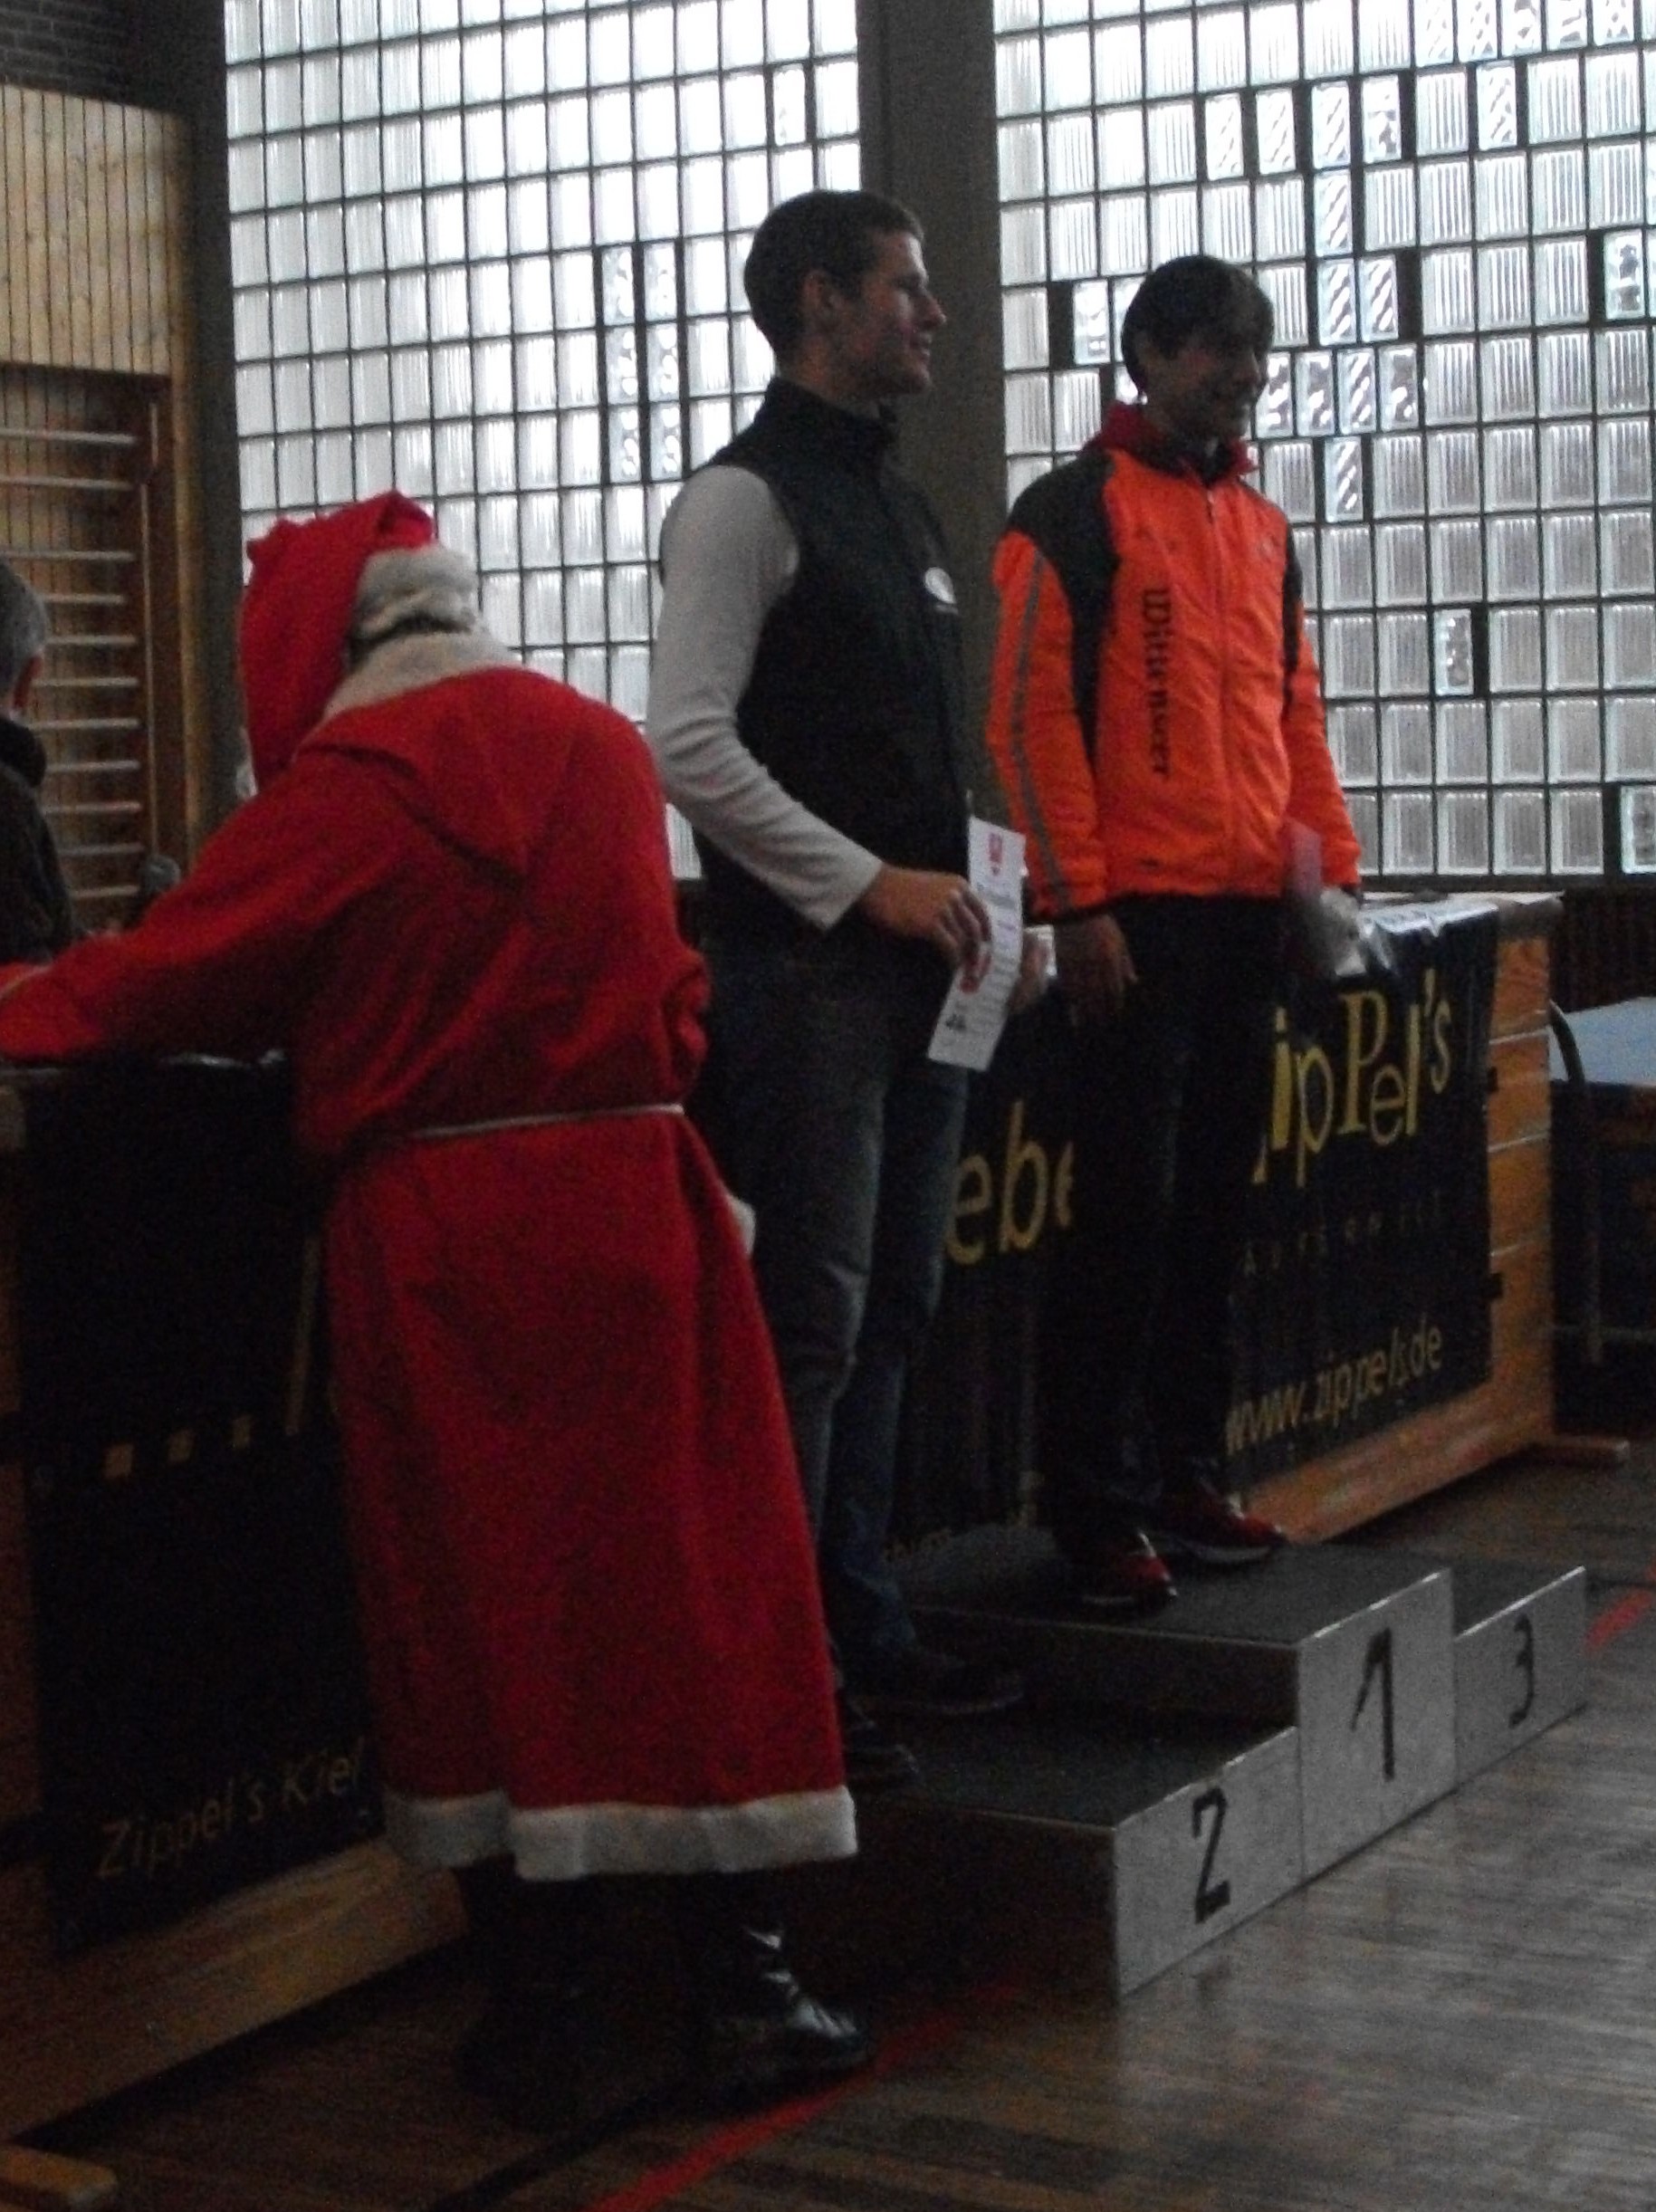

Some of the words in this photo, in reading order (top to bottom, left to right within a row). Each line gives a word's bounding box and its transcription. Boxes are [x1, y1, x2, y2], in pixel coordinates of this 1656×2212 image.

[1351, 1626, 1394, 1782] 1
[1509, 1614, 1535, 1728] 3
[1192, 1787, 1230, 1924] 2
